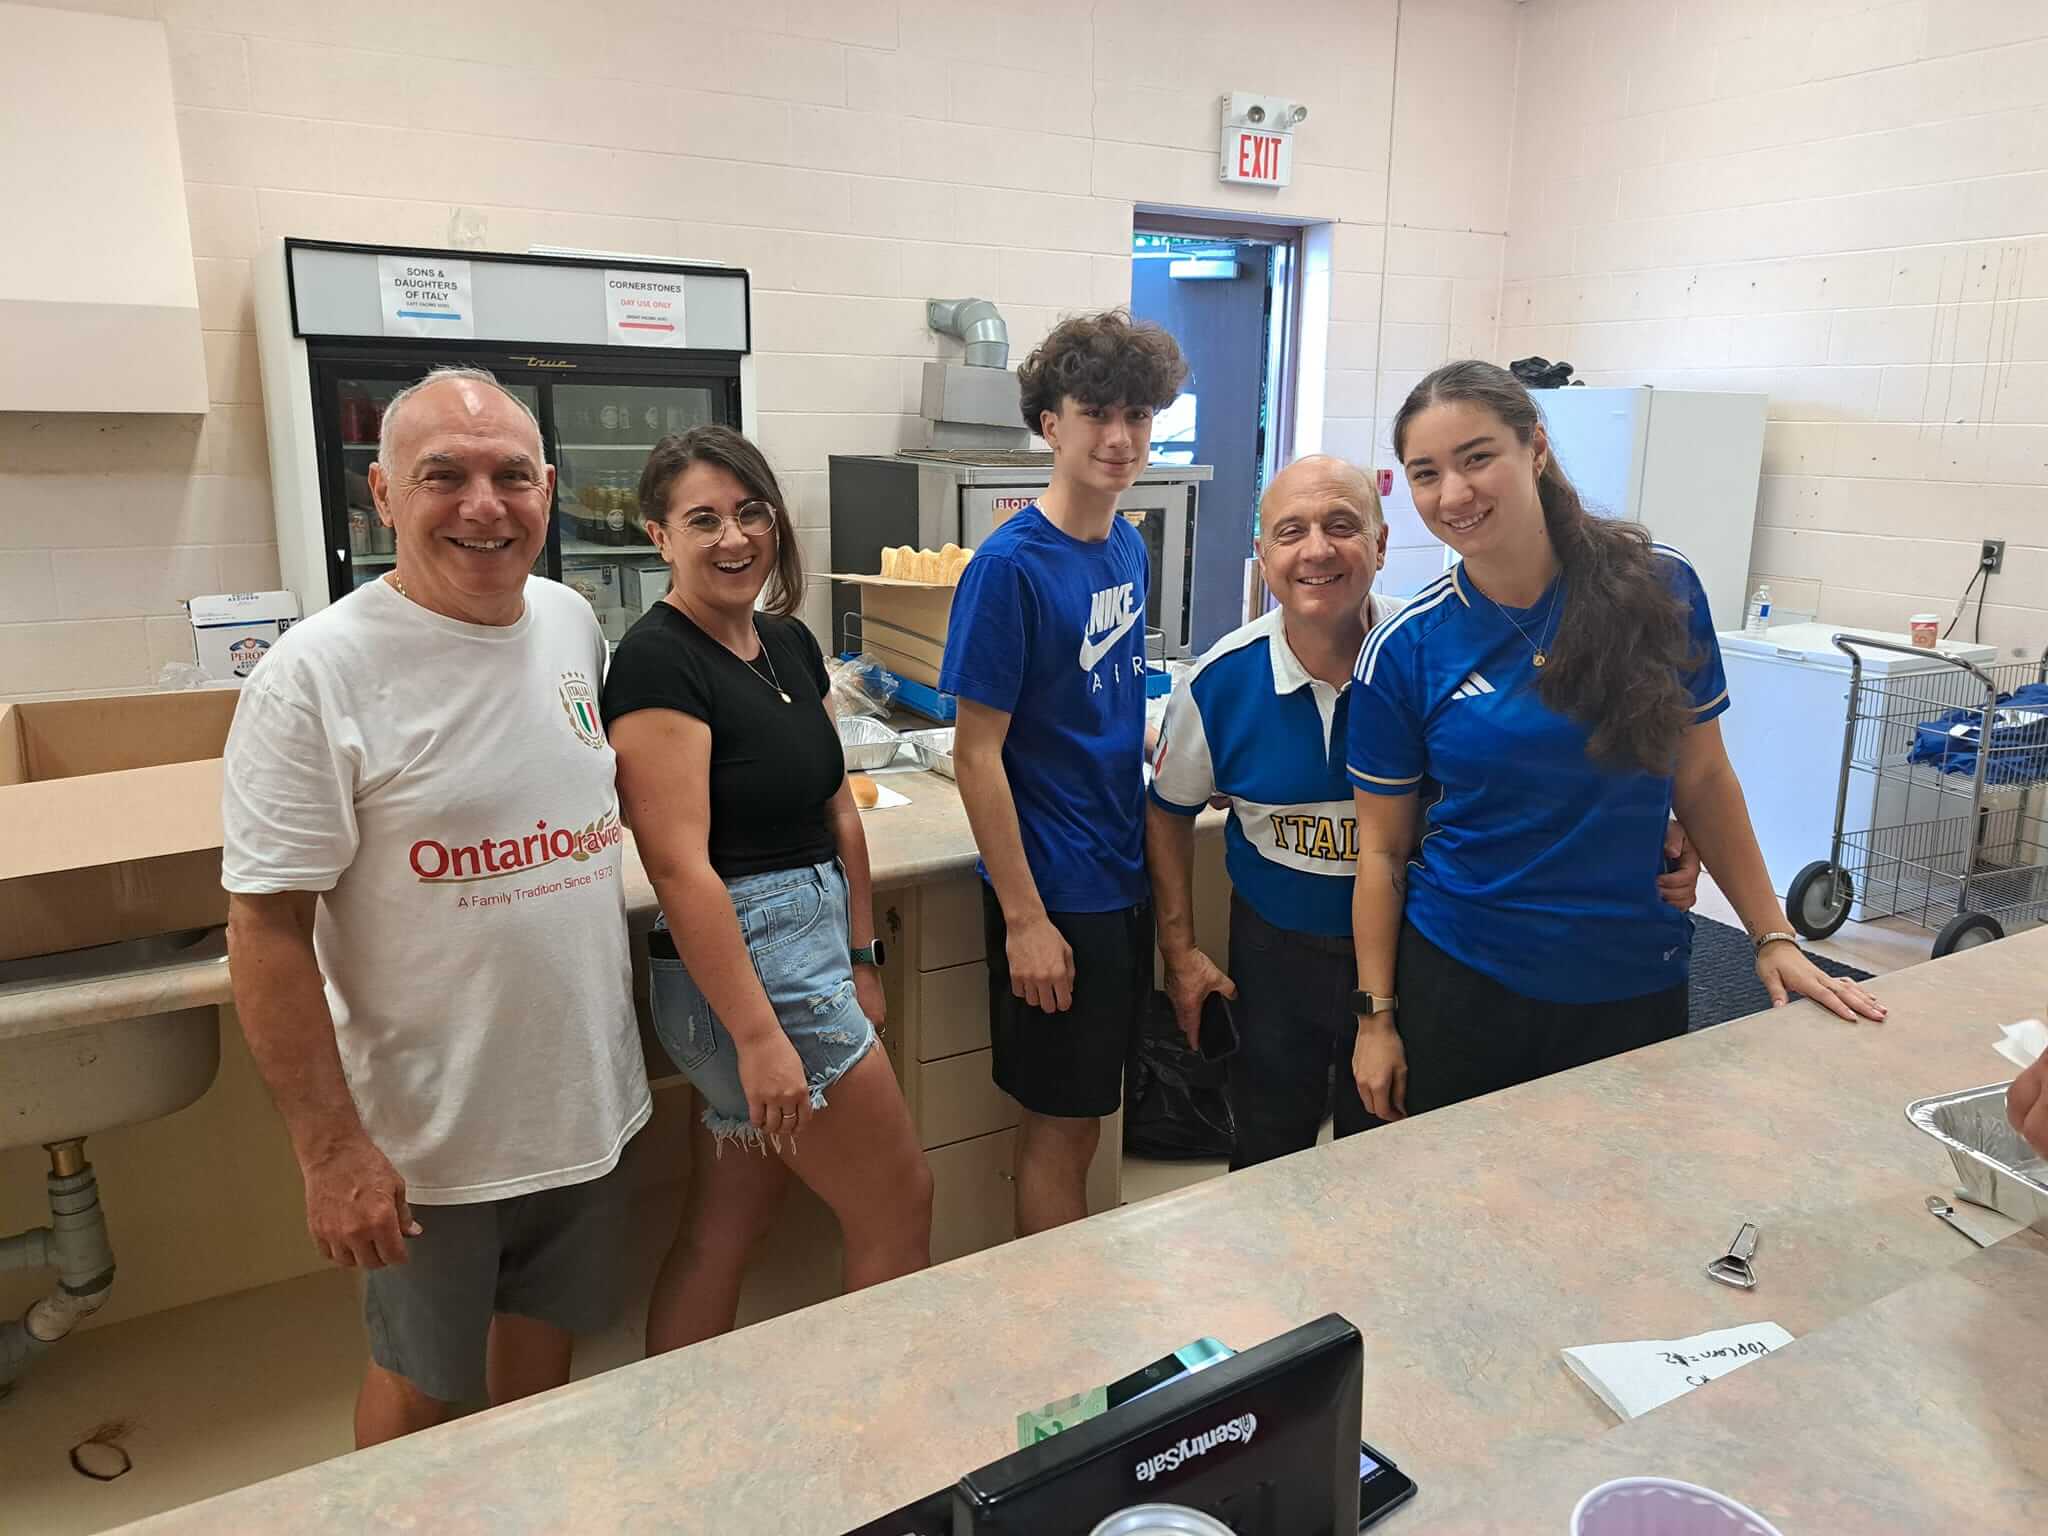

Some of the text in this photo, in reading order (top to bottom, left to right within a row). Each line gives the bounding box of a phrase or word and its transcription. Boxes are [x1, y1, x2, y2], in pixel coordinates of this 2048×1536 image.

[1239, 134, 1282, 180] EXIT
[394, 278, 458, 290] DAUGHTERS
[407, 267, 445, 278] SONS &
[609, 280, 682, 293] CORNERSTONES
[405, 290, 449, 301] OF ITALY
[652, 301, 672, 309] ONLY
[280, 621, 289, 630] 12
[1088, 582, 1134, 636] NIKE
[1092, 655, 1145, 694] AIR
[409, 819, 574, 878] Ontario
[1270, 814, 1360, 862] ITAL
[458, 867, 614, 908] A Family Tradition Since 1973
[1136, 1418, 1242, 1481] SentrySafe
